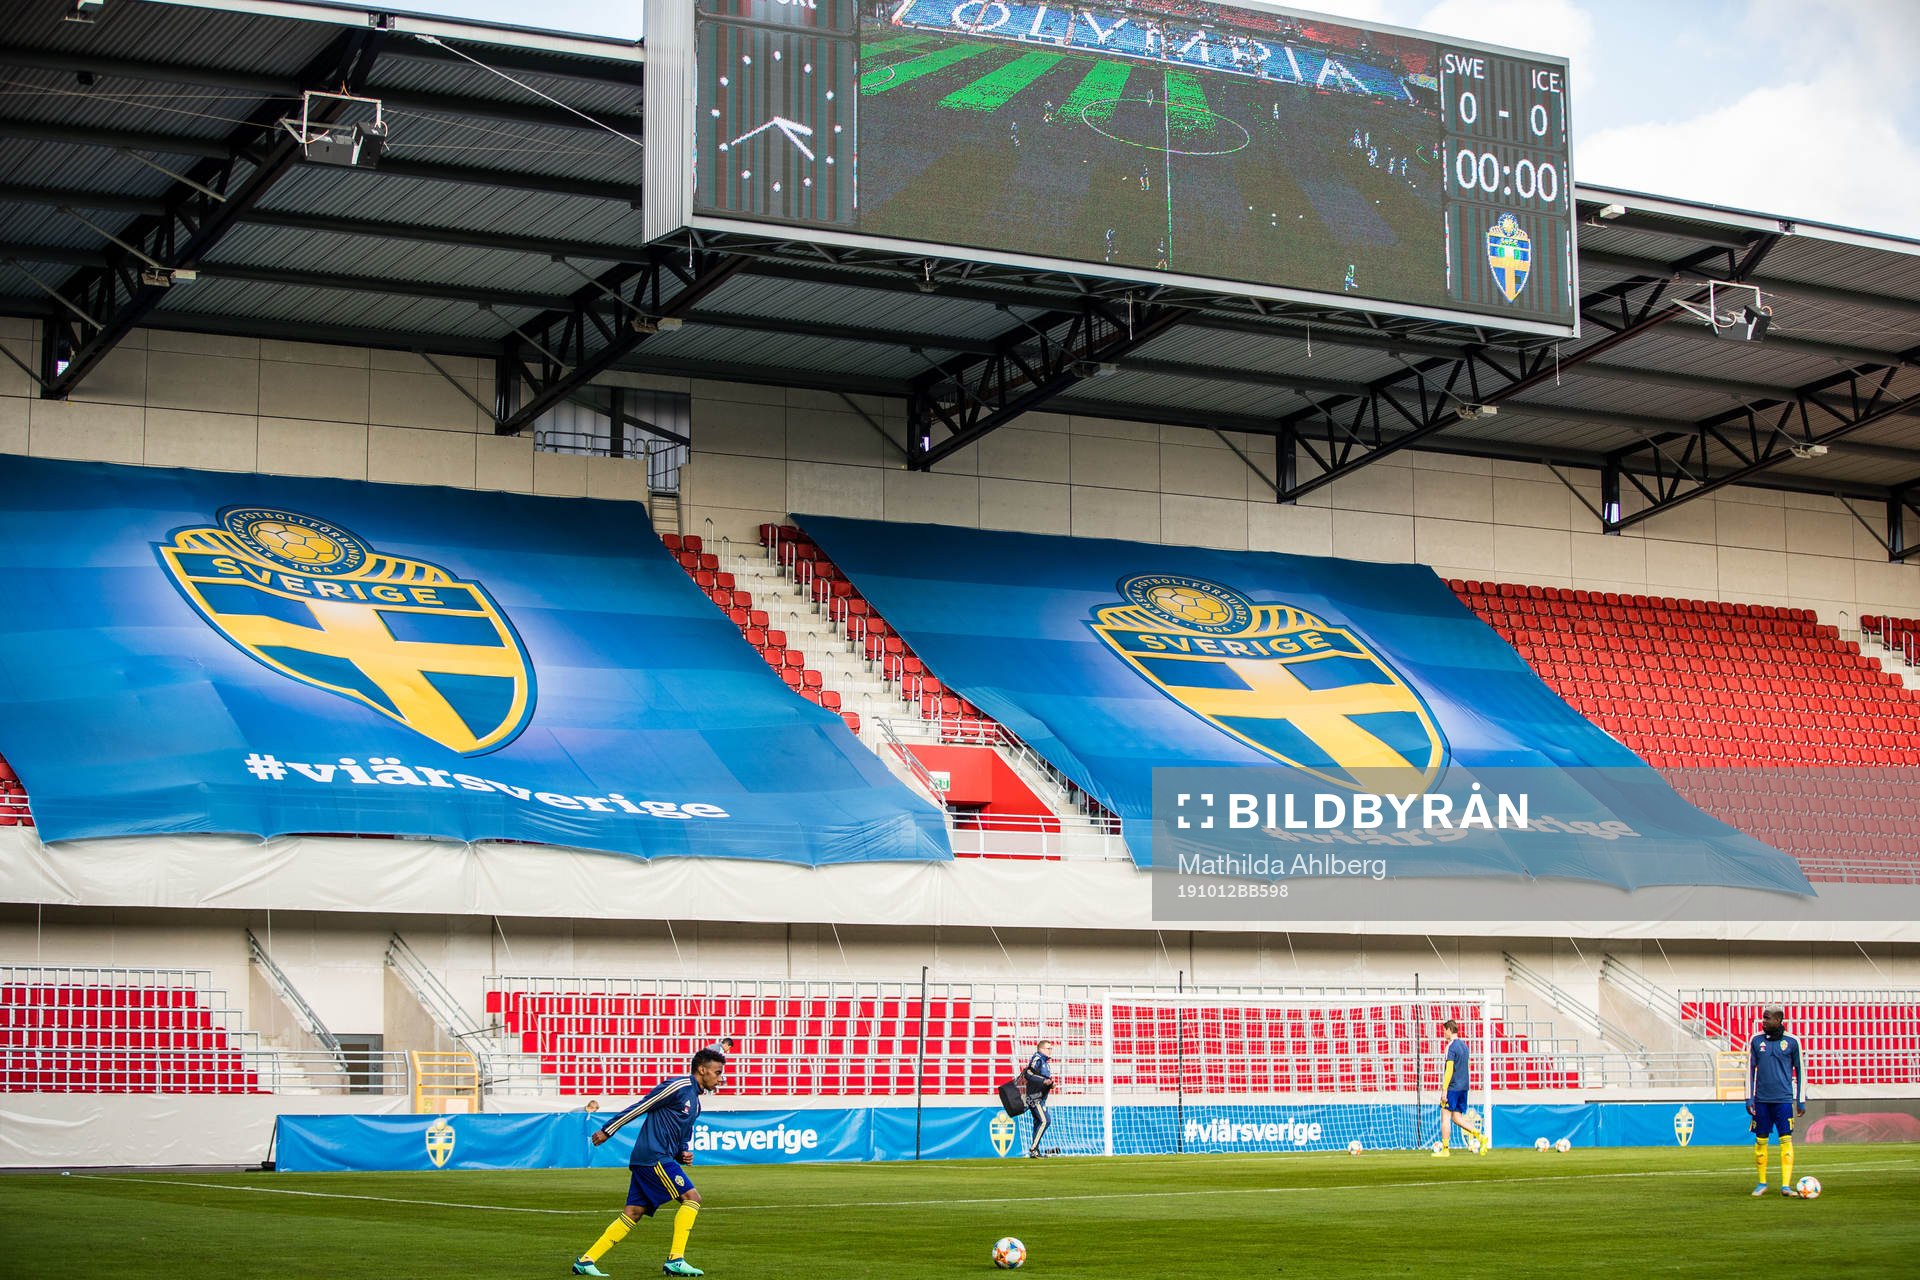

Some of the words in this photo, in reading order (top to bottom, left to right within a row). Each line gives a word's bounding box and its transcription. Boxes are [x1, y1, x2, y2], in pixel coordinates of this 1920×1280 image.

[1445, 54, 1485, 79] SWE
[1532, 69, 1560, 93] ICE
[1460, 92, 1477, 124] 0
[1531, 104, 1548, 136] 0
[1455, 149, 1557, 202] 00:00
[232, 518, 274, 558] SVENSKA
[238, 511, 361, 568] FOTBOLLFÖRBUNDET
[212, 558, 445, 605] SVERIGE
[1134, 578, 1248, 625] FOTBOLLFÖRBUNDET
[1138, 631, 1331, 656] SVERIGE
[244, 753, 730, 819] #viärsverige
[1184, 1117, 1321, 1146] #viärsverige
